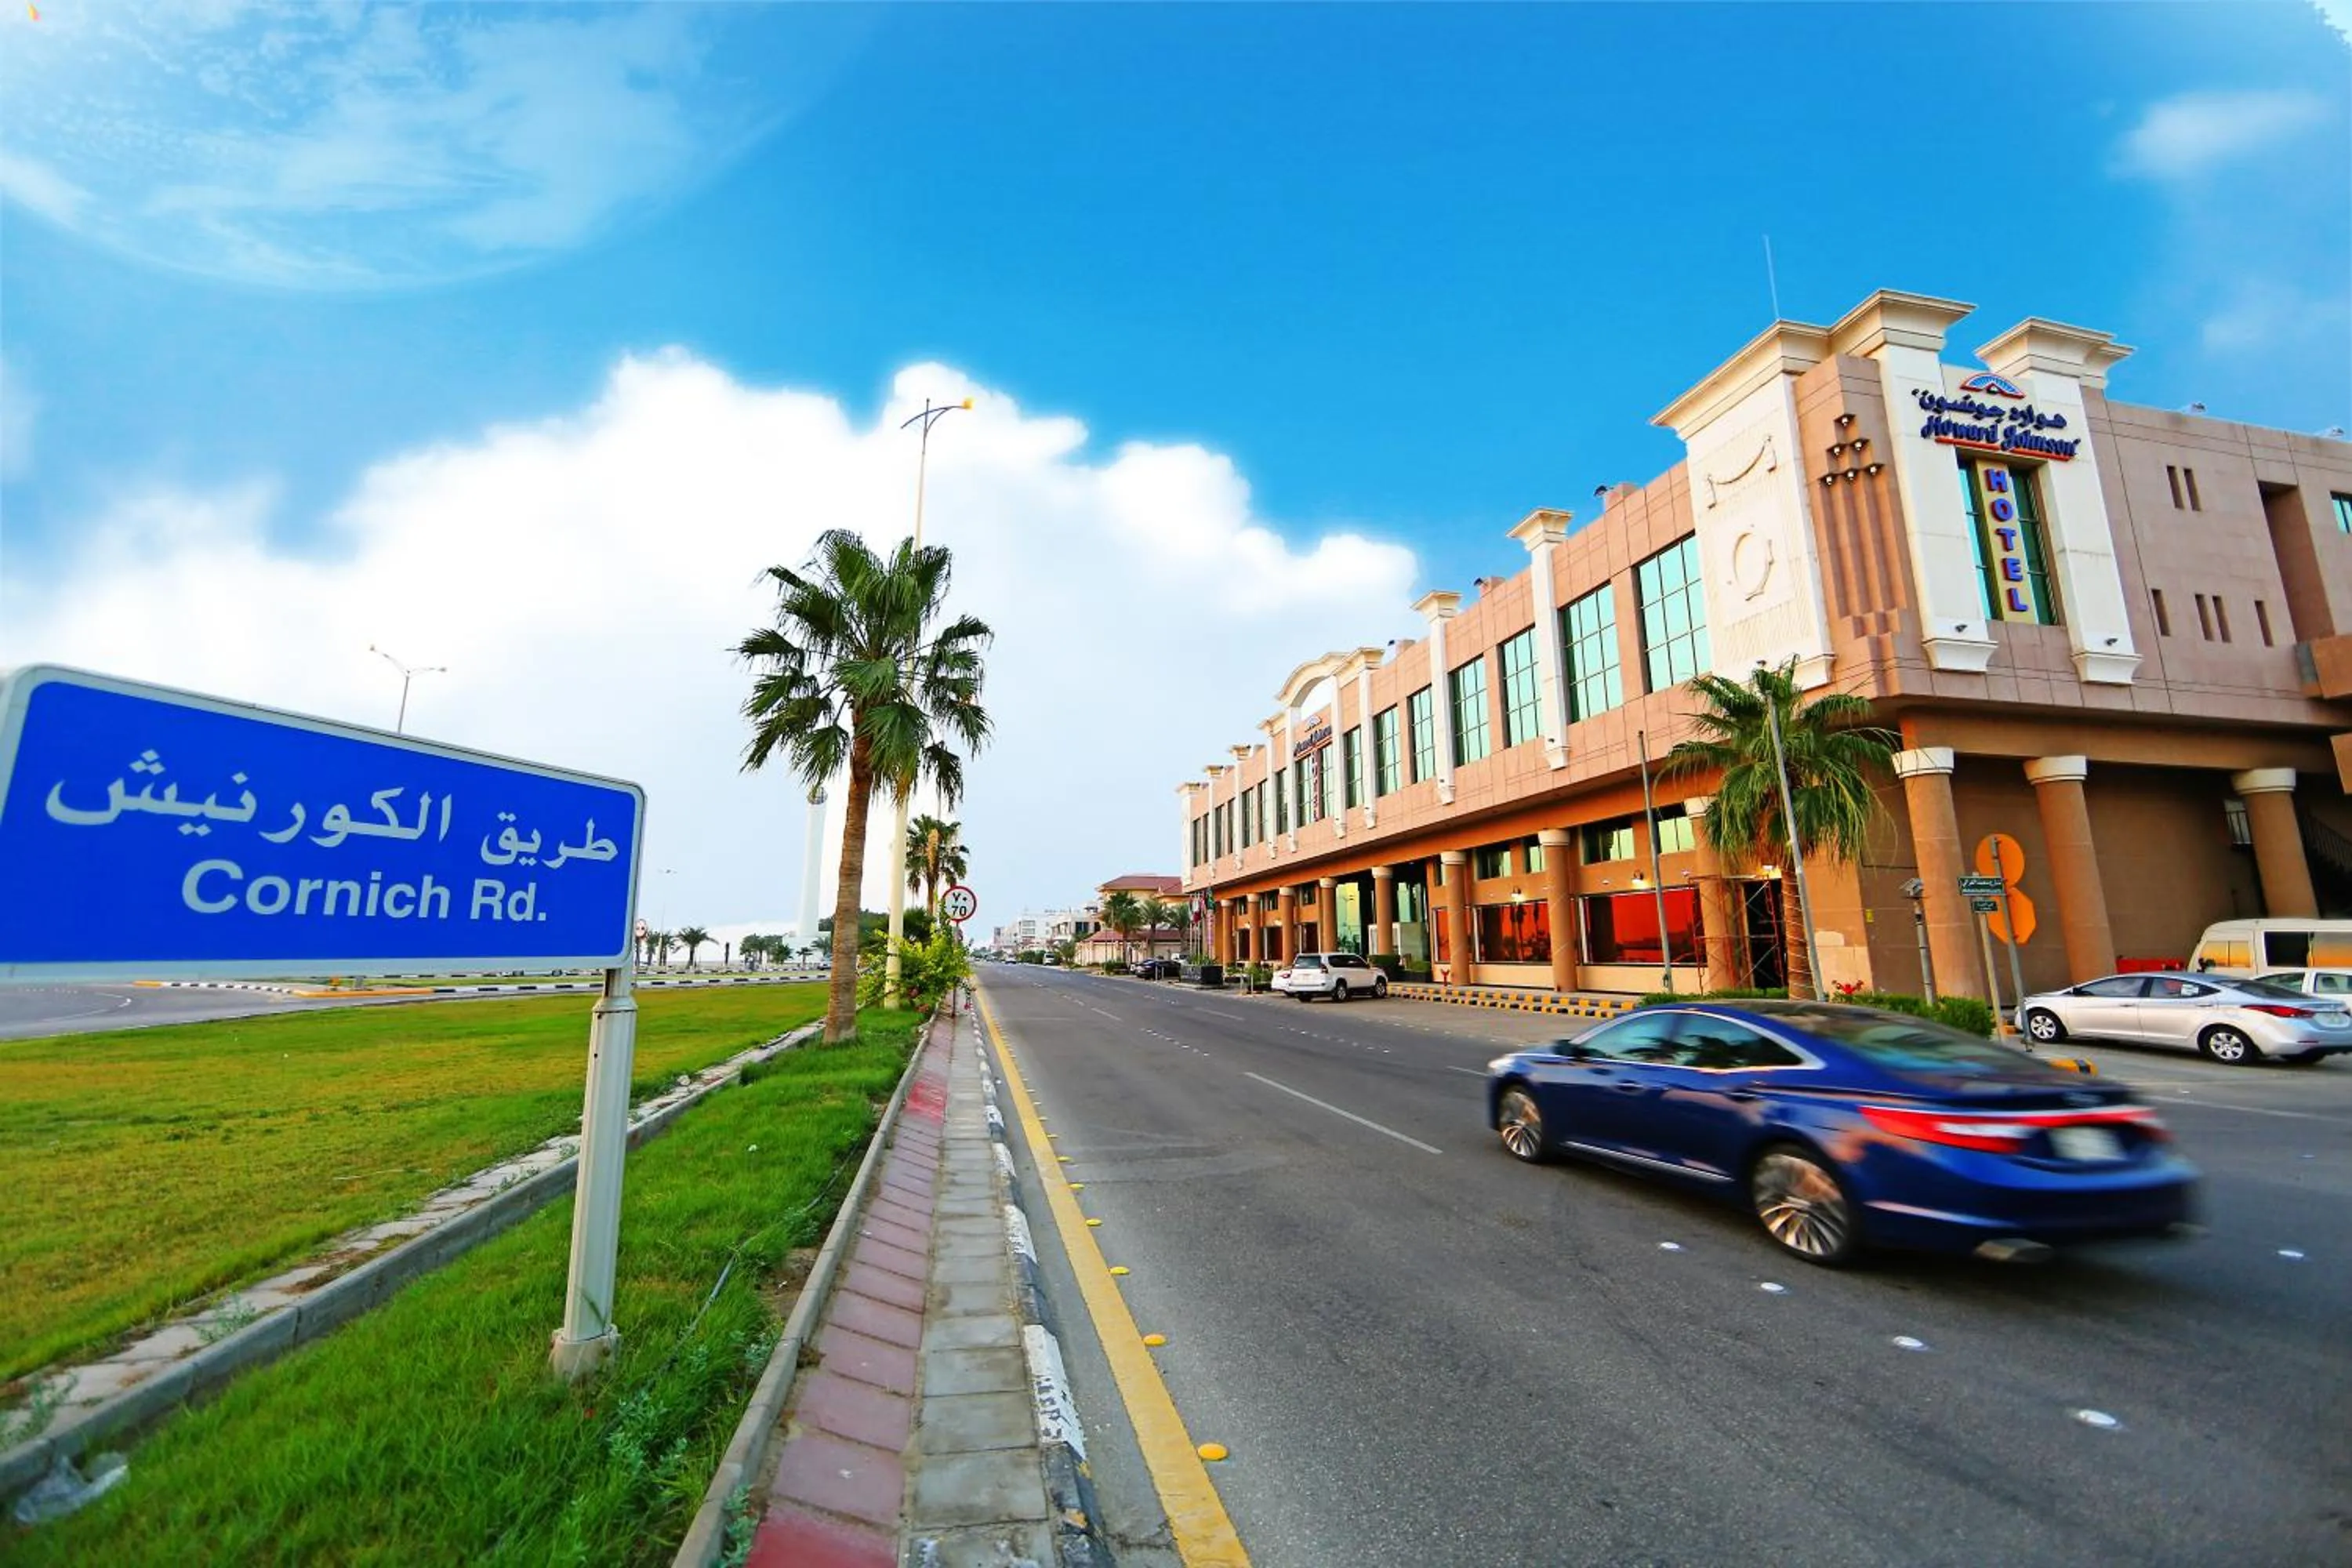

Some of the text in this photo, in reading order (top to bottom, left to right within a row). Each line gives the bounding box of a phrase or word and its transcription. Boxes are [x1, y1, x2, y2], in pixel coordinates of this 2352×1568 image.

[1920, 415, 2078, 456] Howard Johnson
[1984, 468, 2028, 612] HOTEL
[45, 750, 619, 870] طريق الكورنيش
[182, 860, 547, 922] Cornich Rd.
[952, 906, 967, 916] 70
